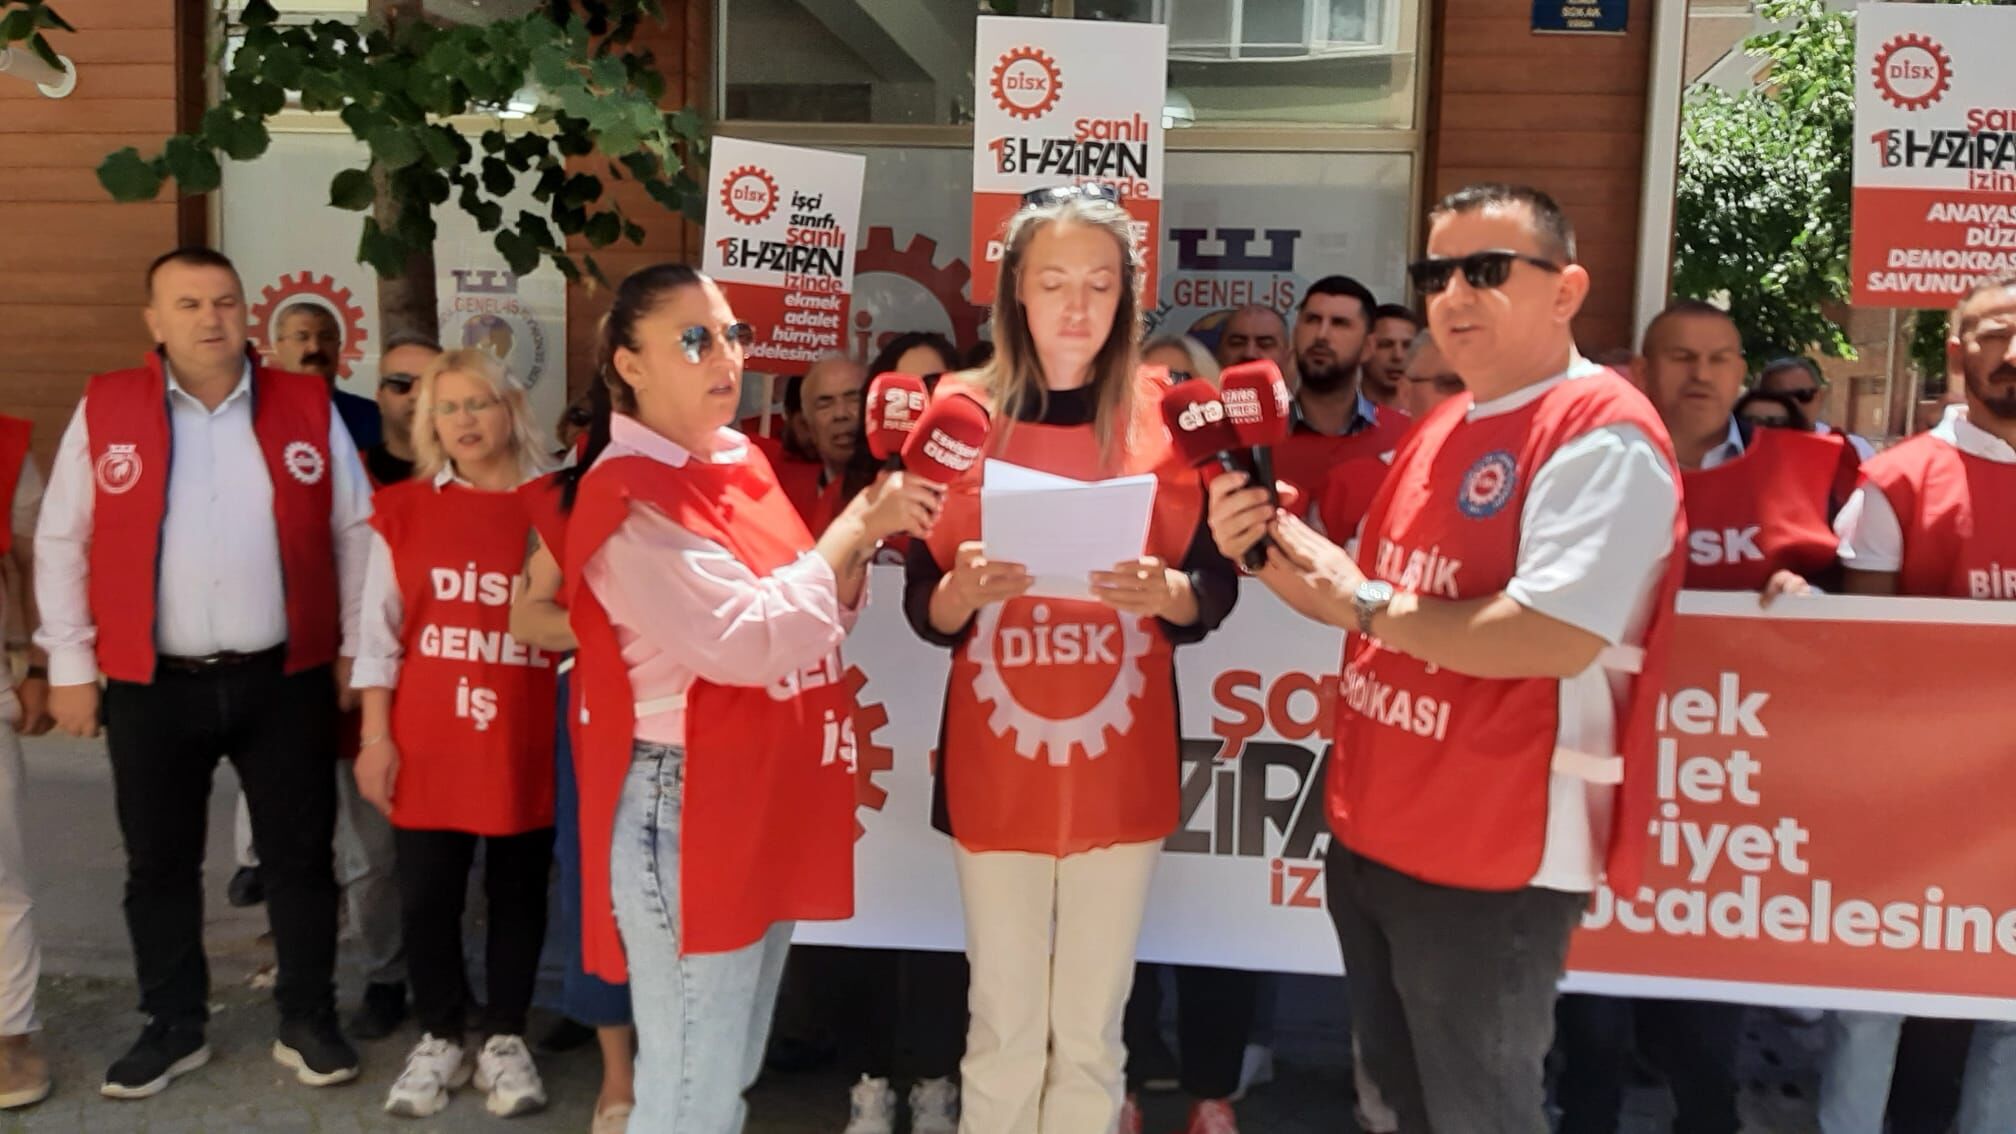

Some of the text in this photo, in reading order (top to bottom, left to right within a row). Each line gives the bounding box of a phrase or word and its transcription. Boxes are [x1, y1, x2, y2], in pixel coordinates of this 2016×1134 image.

[1006, 71, 1047, 91] DİSK
[1889, 59, 1935, 80] DİSK
[1074, 113, 1149, 143] şanlı
[1967, 108, 2016, 137] şa
[733, 185, 767, 203] DİSK
[791, 190, 823, 212] işçi
[786, 225, 846, 248] şanlı
[1966, 223, 2016, 247] DÜZ
[784, 274, 843, 293] izinde
[784, 294, 841, 311] ekmek
[784, 310, 840, 328] adalet
[772, 324, 839, 348] hürriyet
[1001, 604, 1118, 668] DİSK
[456, 676, 498, 731] İŞ
[1656, 672, 1770, 737] ek
